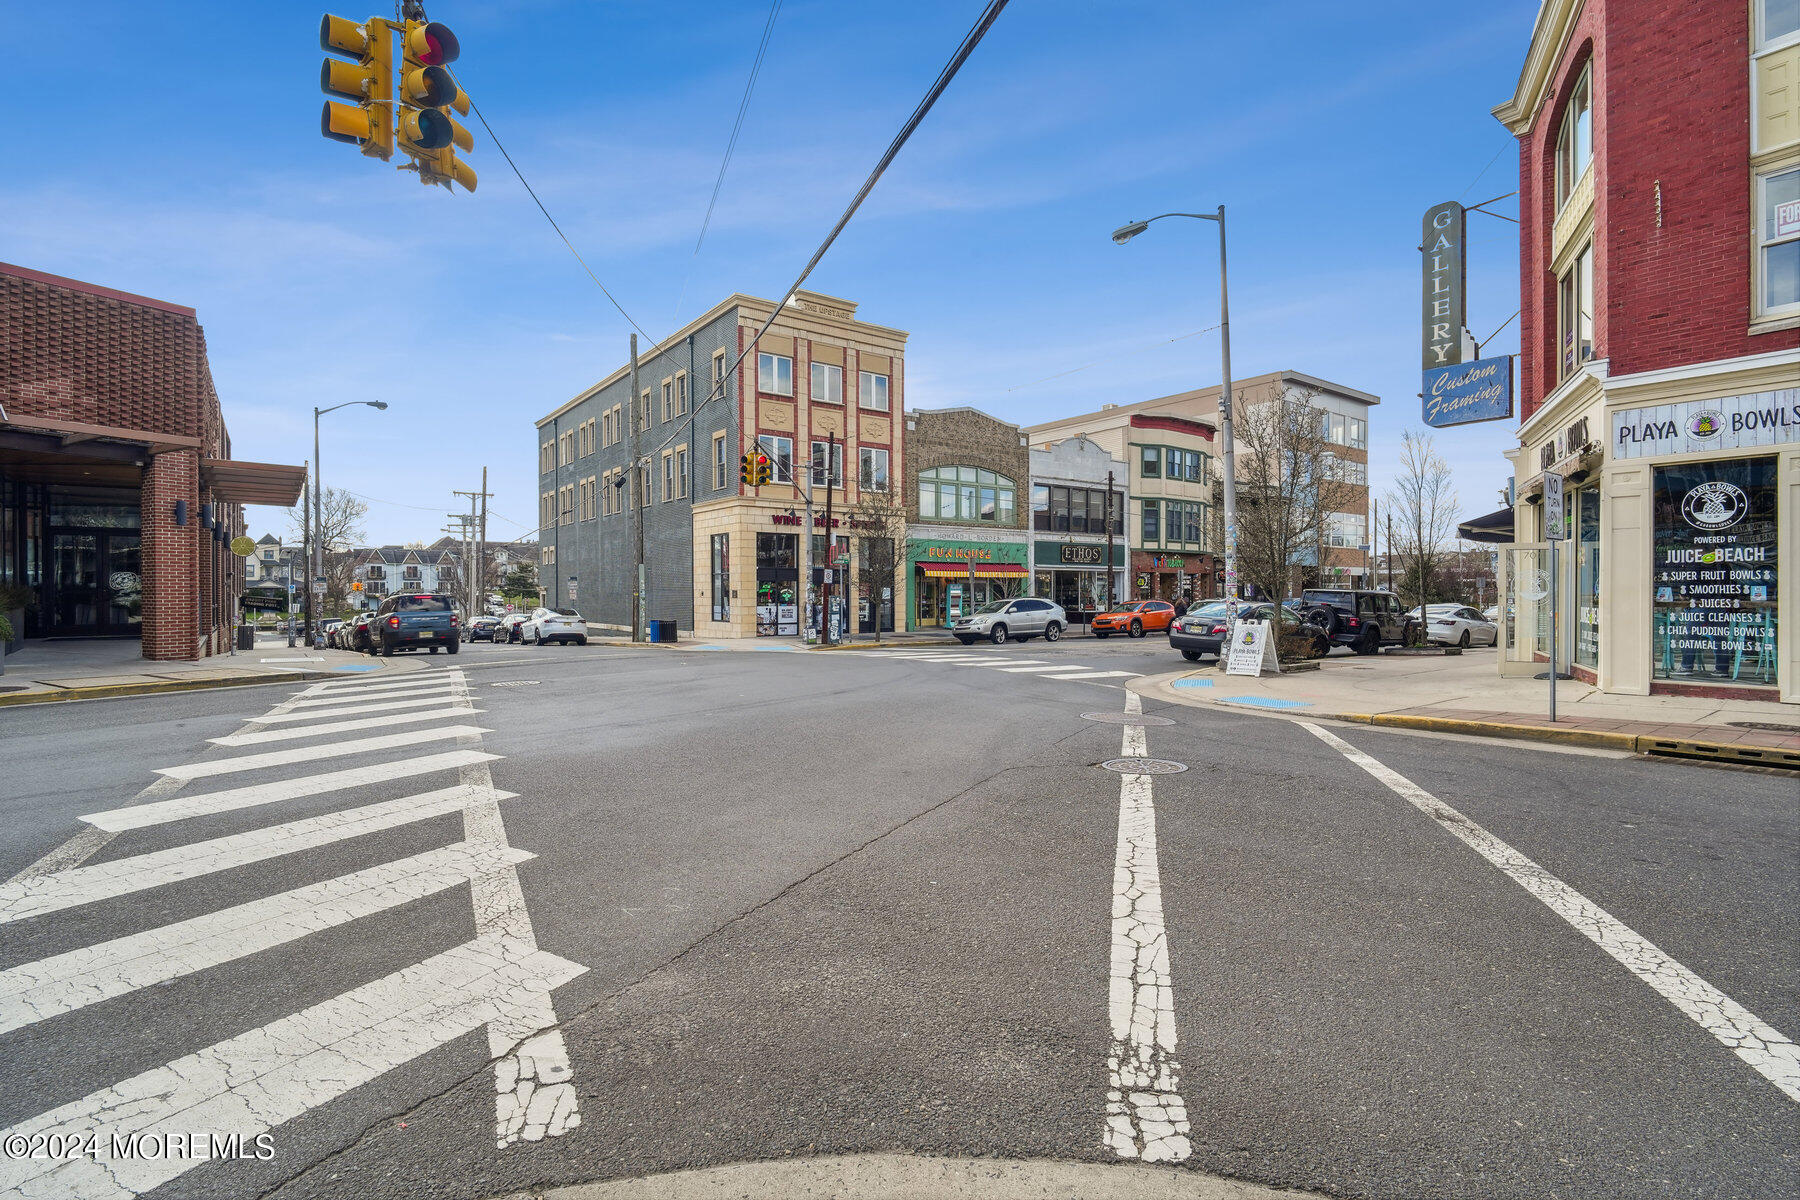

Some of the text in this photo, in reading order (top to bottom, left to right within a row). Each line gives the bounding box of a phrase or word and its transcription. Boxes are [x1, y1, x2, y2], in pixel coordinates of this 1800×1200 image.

[1430, 208, 1453, 363] GALLERY
[1431, 363, 1498, 396] Custom
[1427, 382, 1504, 422] Framing
[1619, 405, 1800, 444] PLAYA BOWLS
[1548, 477, 1558, 494] NO
[1690, 483, 1740, 498] PLAYA BOWLS
[771, 514, 802, 526] WINE
[1693, 535, 1737, 544] POWERED BY
[1065, 547, 1099, 559] ETHOS
[1665, 547, 1765, 564] JUICE BEACH
[1670, 570, 1761, 580] SUPER FRUIT BOWLS
[1689, 584, 1741, 594] SMOOTHIES
[1698, 599, 1732, 608] JUICES
[1678, 612, 1753, 622] JUICE CLEANSES
[1667, 625, 1765, 637] CHIA PUDDING BOWLS
[1679, 639, 1752, 651] OATMEAL BOWLS
